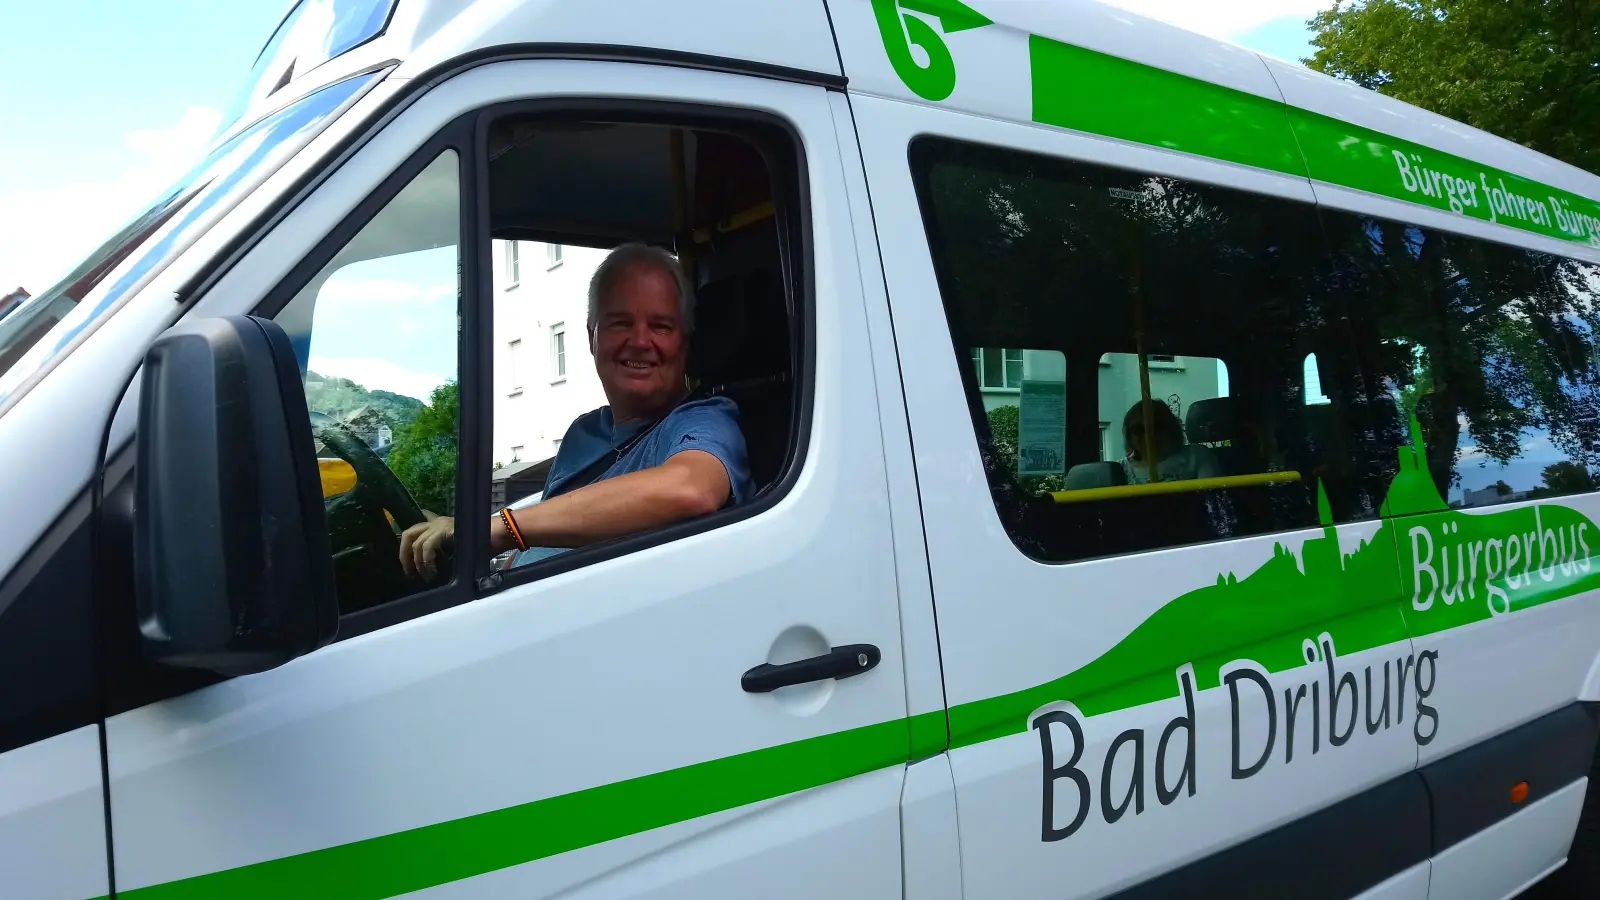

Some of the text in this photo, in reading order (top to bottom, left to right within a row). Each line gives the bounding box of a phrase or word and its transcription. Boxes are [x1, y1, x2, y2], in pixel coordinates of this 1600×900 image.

[1391, 149, 1478, 216] Bürger
[1479, 171, 1552, 228] fahren
[1408, 505, 1591, 616] Bürgerbus
[1032, 640, 1439, 843] Bad Driburg
